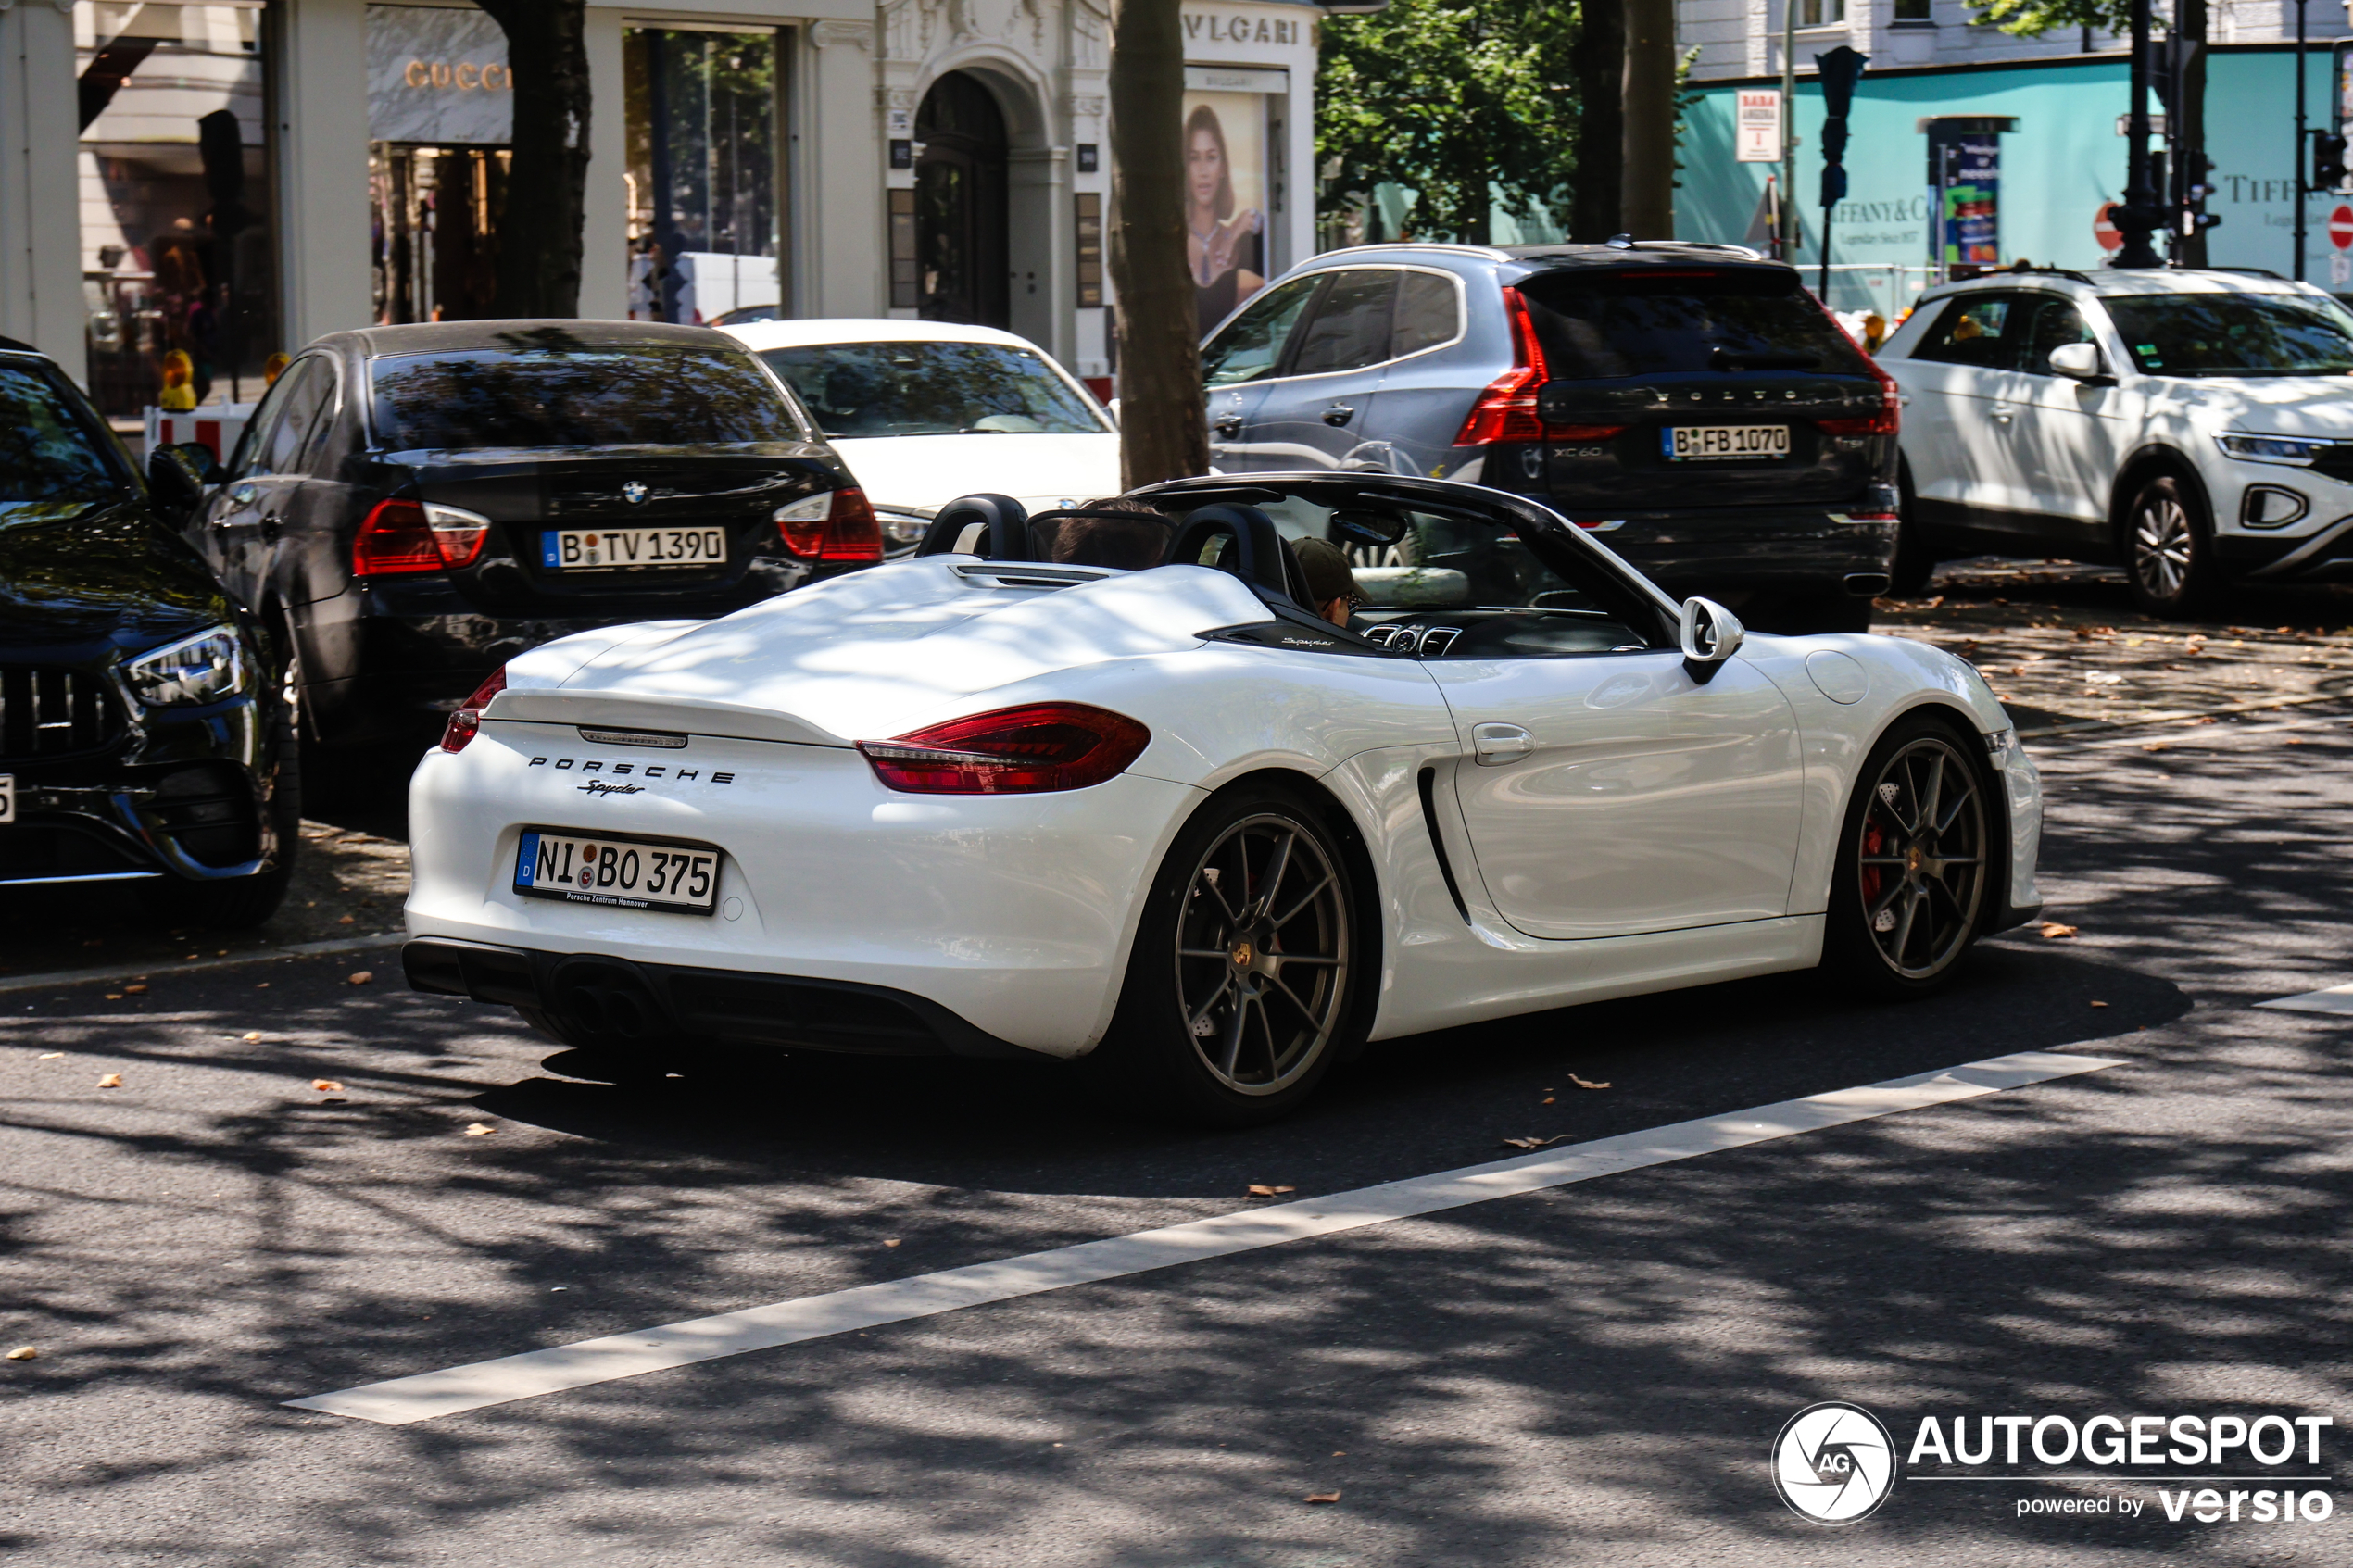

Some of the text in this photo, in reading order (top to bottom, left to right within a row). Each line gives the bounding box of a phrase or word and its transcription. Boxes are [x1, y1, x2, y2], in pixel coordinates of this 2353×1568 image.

[1183, 14, 1298, 44] VLGARI
[404, 60, 514, 91] GUCCI
[1743, 95, 1775, 107] BABA
[1655, 390, 1797, 402] VOLVO
[1676, 430, 1689, 453] B
[561, 533, 582, 564] B
[528, 756, 736, 784] PORSCHE
[576, 779, 646, 797] Spyder
[535, 839, 574, 884] NI
[647, 851, 713, 897] 375
[566, 892, 648, 908] Porsche Zentrum Hannover
